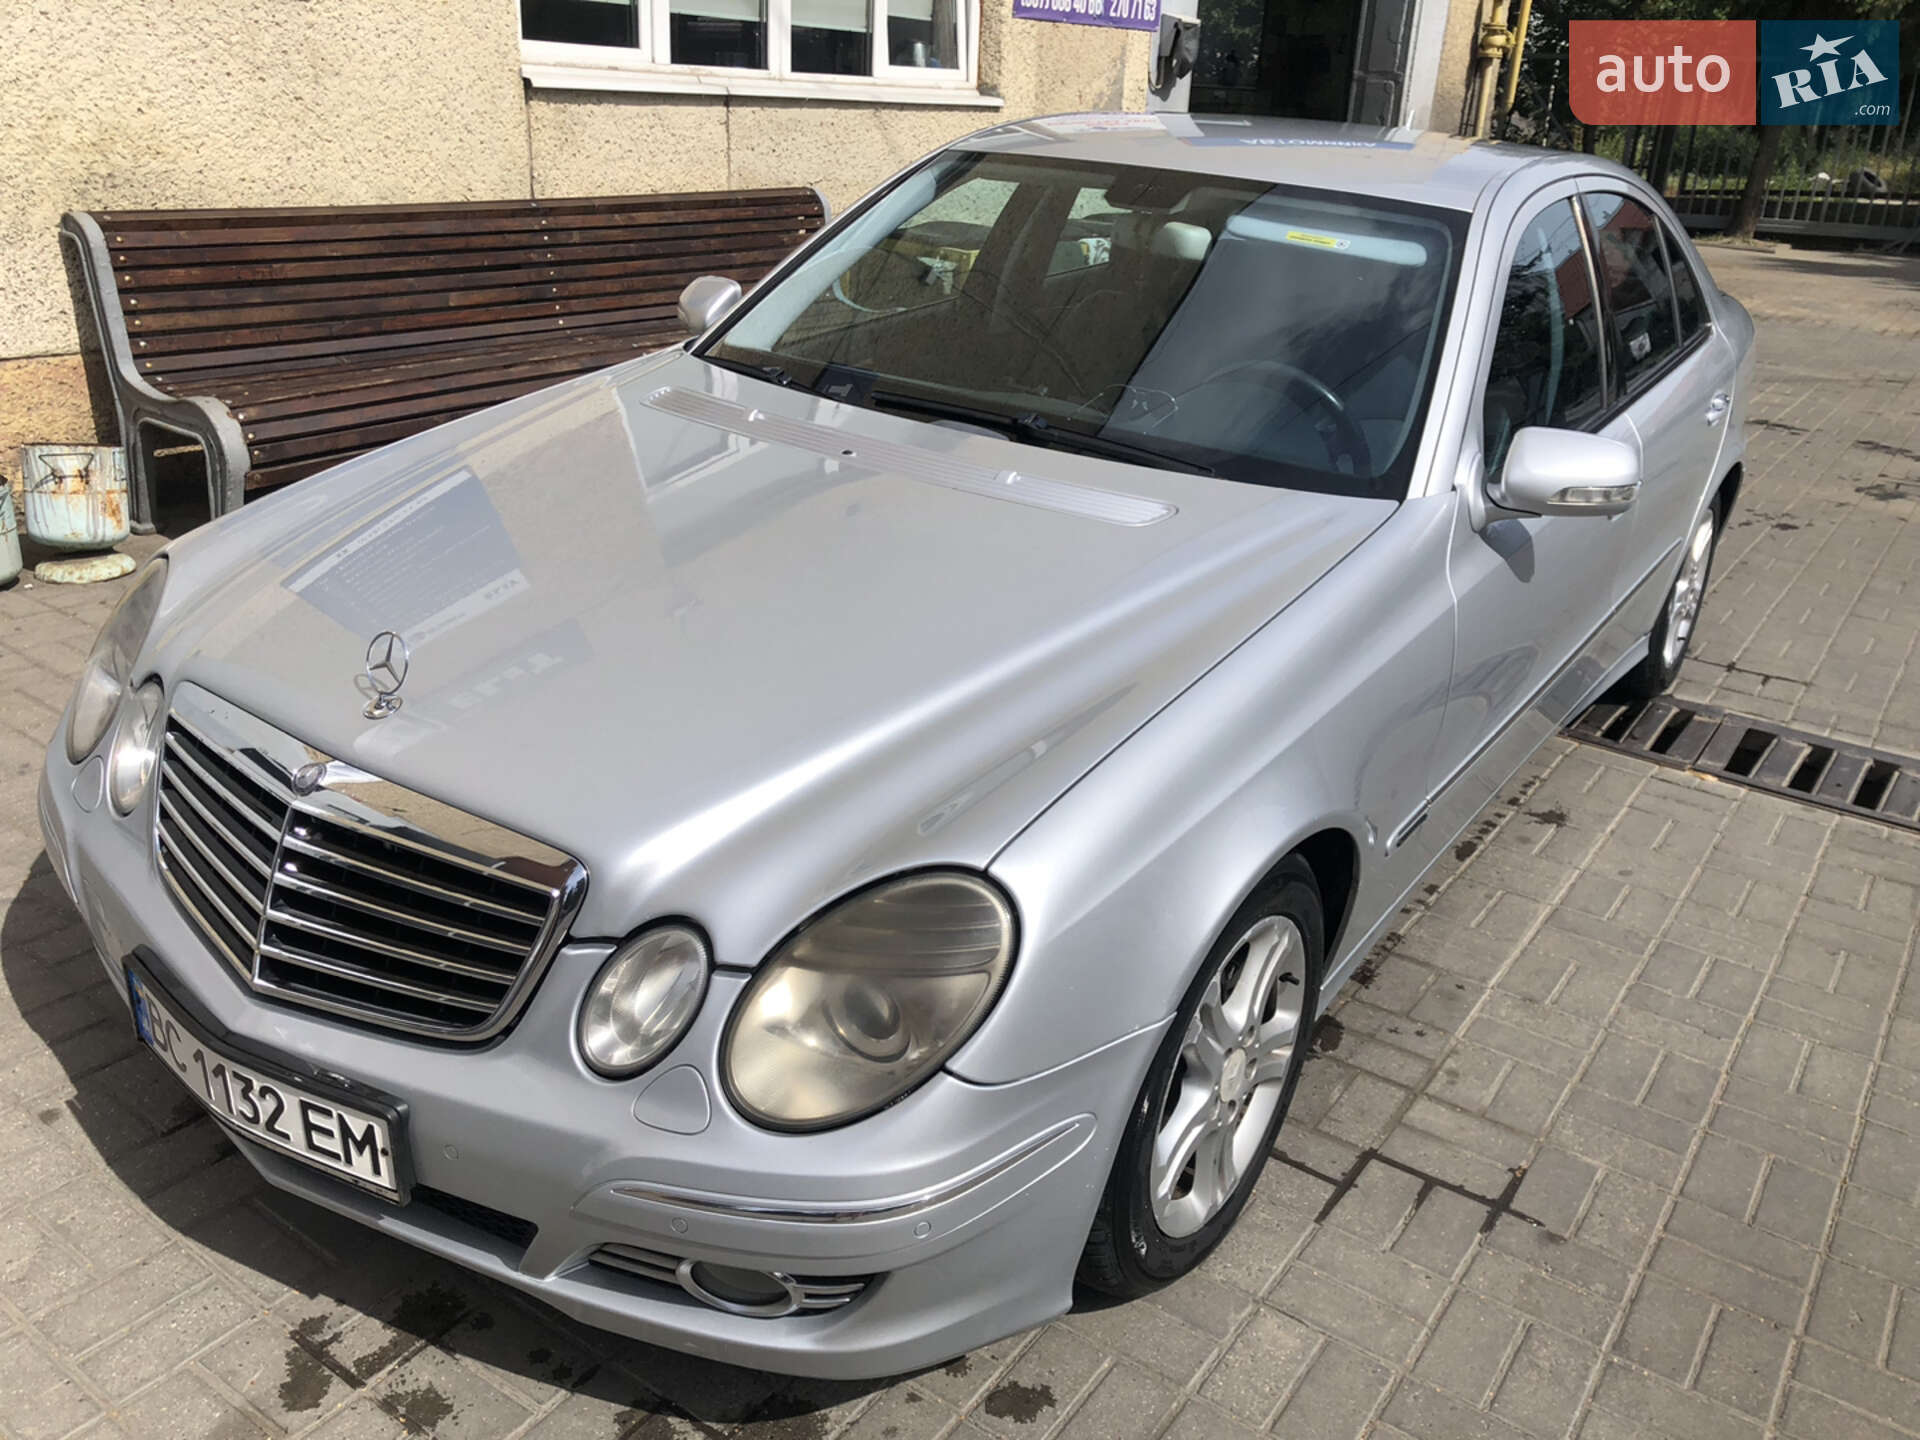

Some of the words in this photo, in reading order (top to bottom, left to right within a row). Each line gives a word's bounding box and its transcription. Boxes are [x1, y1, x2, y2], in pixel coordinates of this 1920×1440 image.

[145, 993, 187, 1073] BC
[193, 1049, 291, 1140] 1132
[299, 1099, 382, 1177] EM
